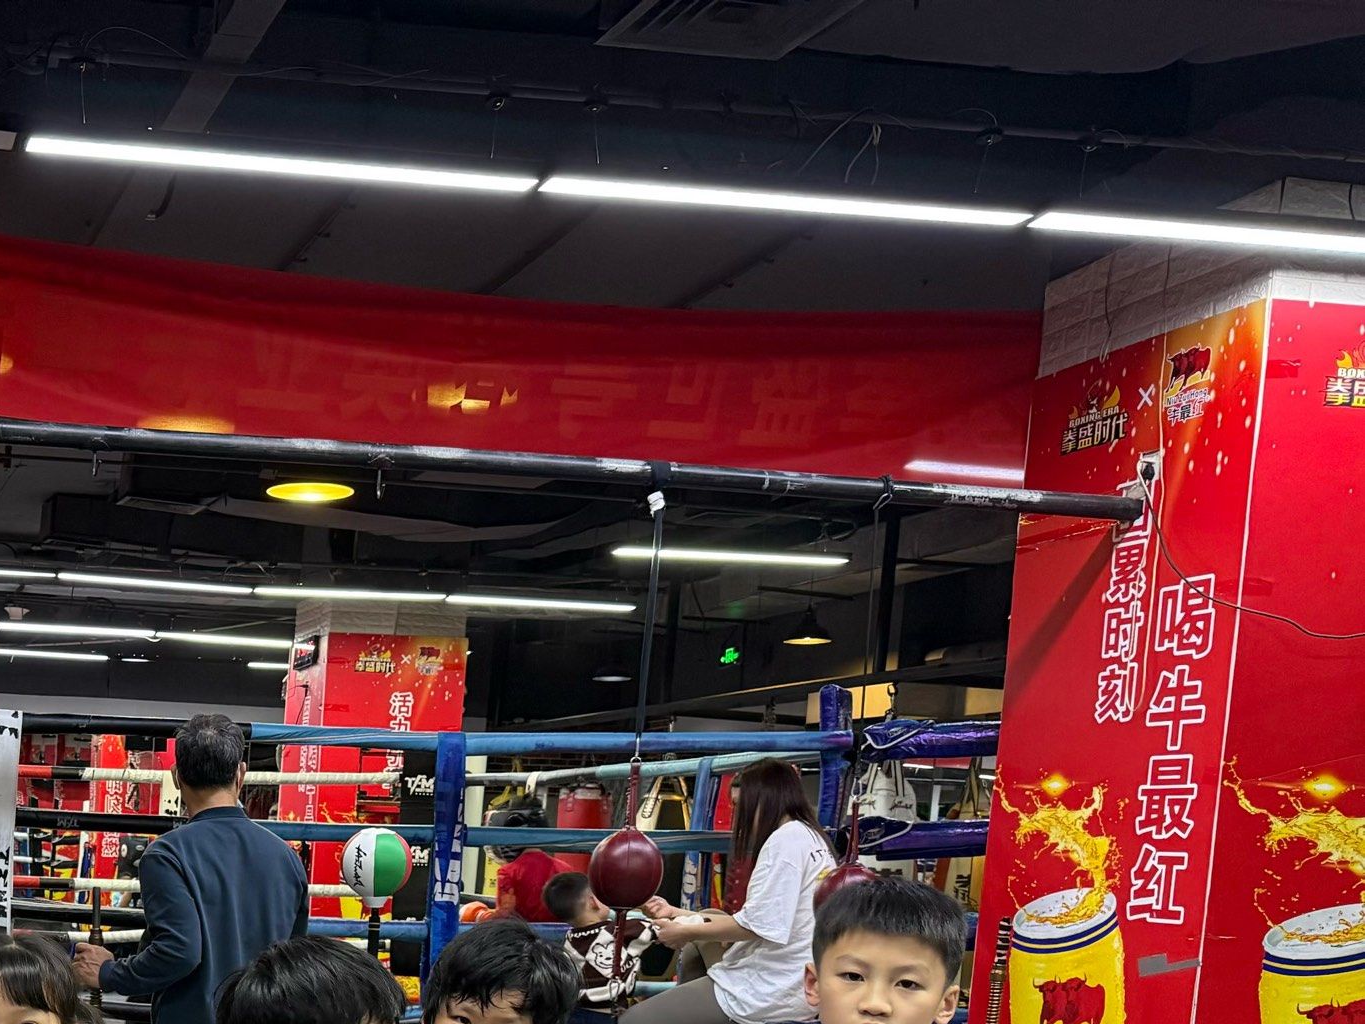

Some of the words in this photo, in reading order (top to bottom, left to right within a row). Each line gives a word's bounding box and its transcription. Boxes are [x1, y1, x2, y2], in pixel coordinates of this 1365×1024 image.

[1062, 413, 1128, 453] 拳盛时代
[1069, 410, 1102, 428] BOXING
[1103, 405, 1120, 417] ERA
[1126, 573, 1216, 925] 喝牛最红
